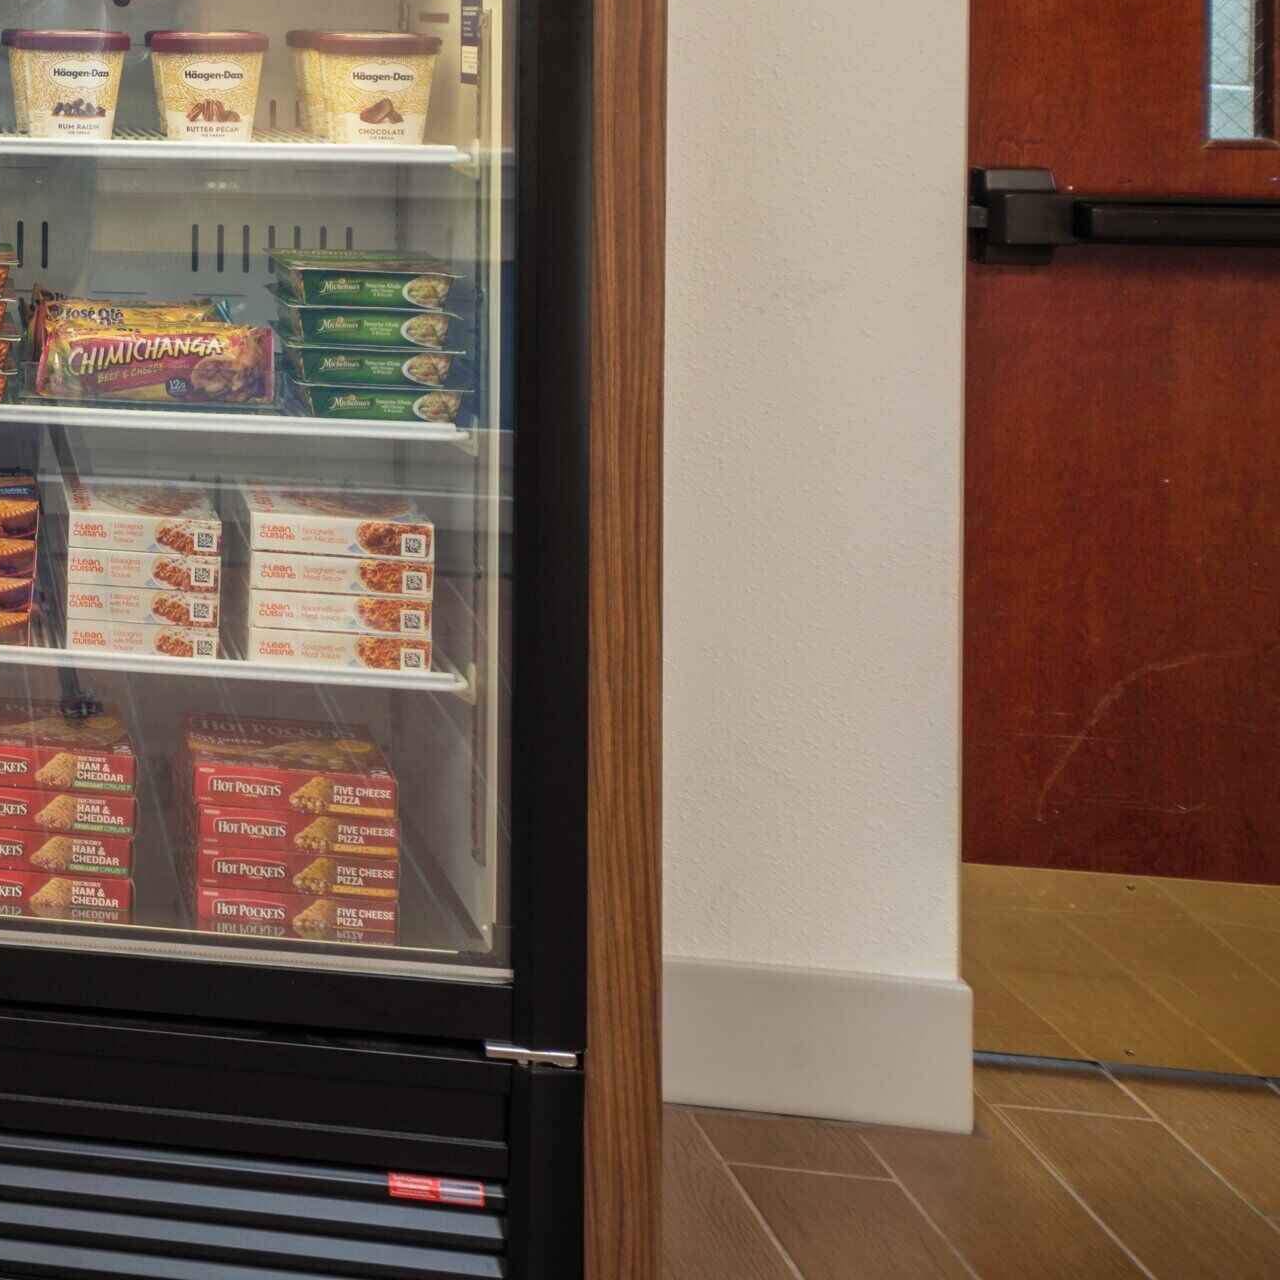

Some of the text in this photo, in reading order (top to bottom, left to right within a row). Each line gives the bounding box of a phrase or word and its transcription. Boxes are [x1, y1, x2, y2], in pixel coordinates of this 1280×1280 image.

[53, 67, 110, 79] Häagen-Dazs
[184, 69, 244, 82] Häagen-Dazs
[352, 71, 415, 83] Häagen-Dazs
[186, 126, 239, 134] BUTTER PECAN
[359, 128, 405, 136] CHOCOLATE
[321, 279, 361, 292] Michelina's
[66, 307, 124, 320] José Olé
[67, 333, 224, 376] CHIMICHANGA
[97, 362, 164, 384] BEEF CHEESE
[77, 762, 110, 772] HAM &
[77, 771, 124, 783] CHEDDAR
[213, 779, 282, 797] HOT POCKETS
[333, 785, 392, 799] FIVE CHEESE
[333, 795, 360, 806] PIZZA
[217, 820, 286, 838] HOT POCKETS
[338, 825, 396, 837] FIVE CHEESE
